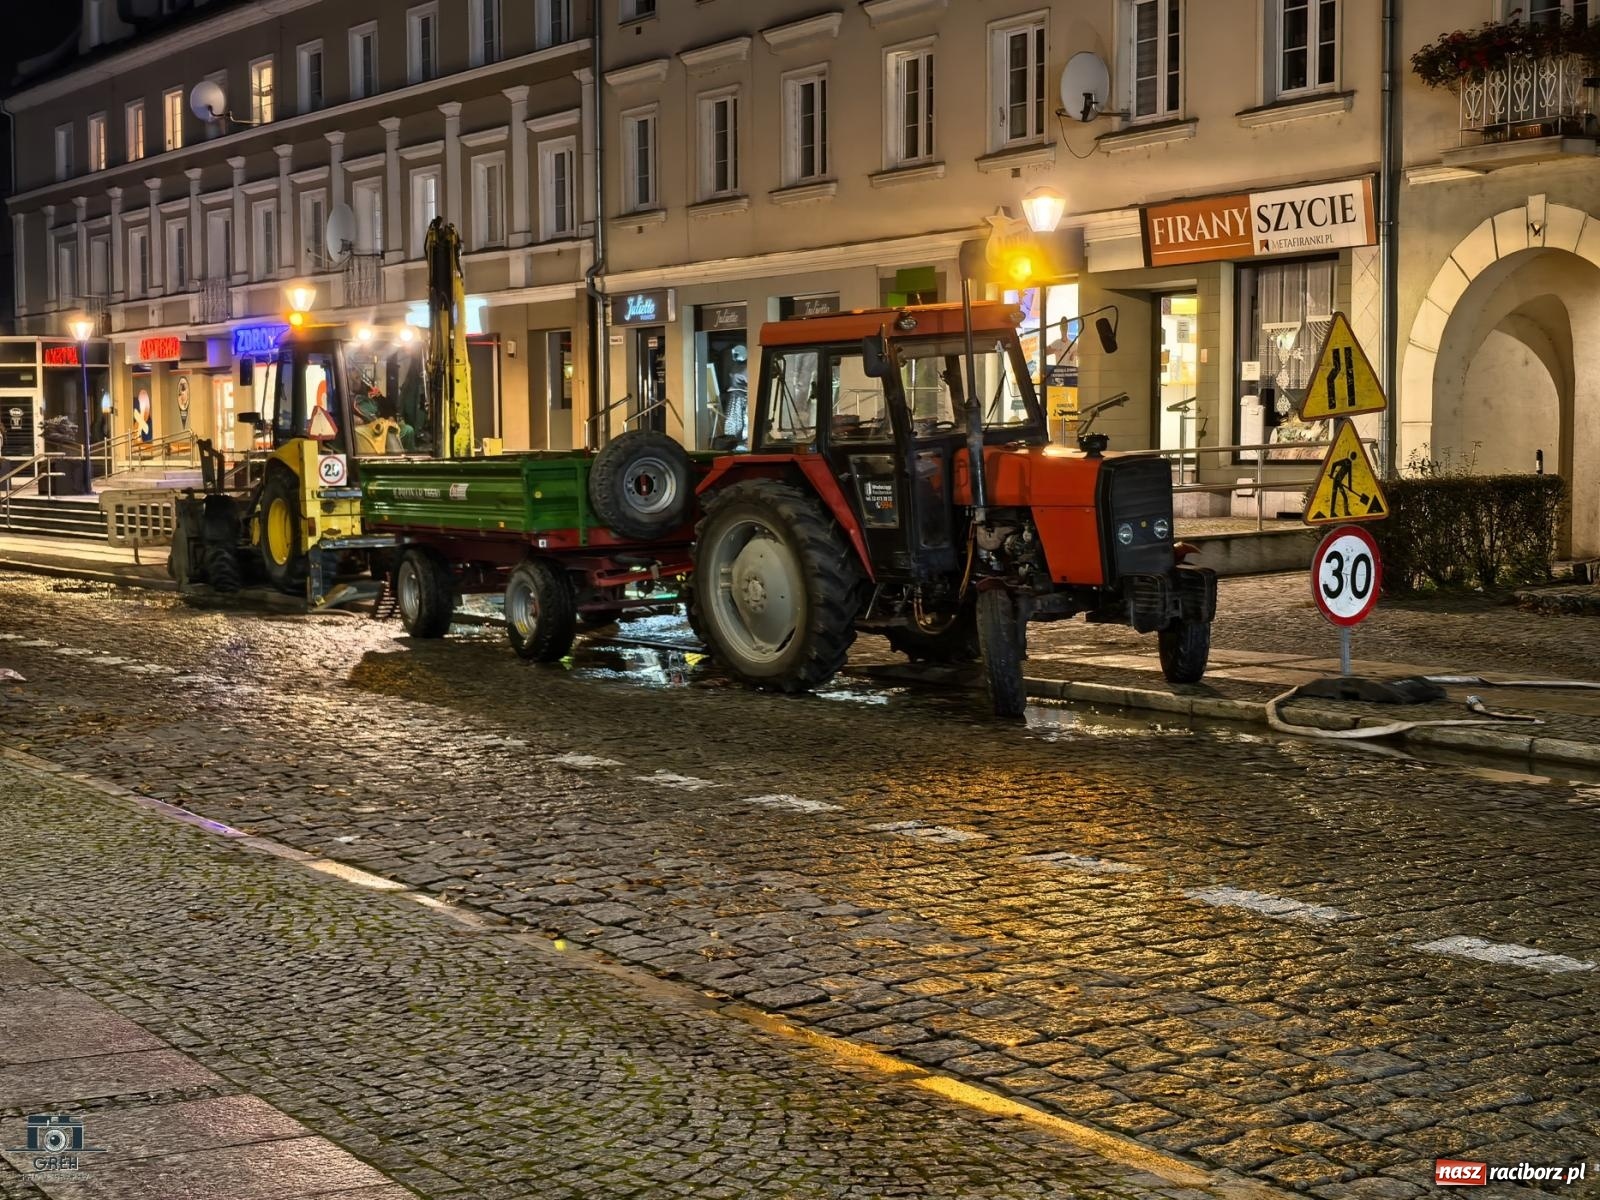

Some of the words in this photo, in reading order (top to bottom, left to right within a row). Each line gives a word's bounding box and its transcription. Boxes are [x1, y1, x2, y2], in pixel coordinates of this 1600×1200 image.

[1152, 207, 1249, 246] FIRANY
[1256, 193, 1357, 234] SZYCIE
[624, 294, 656, 321] Juliette
[713, 308, 739, 328] Juliette
[1322, 550, 1372, 600] 30
